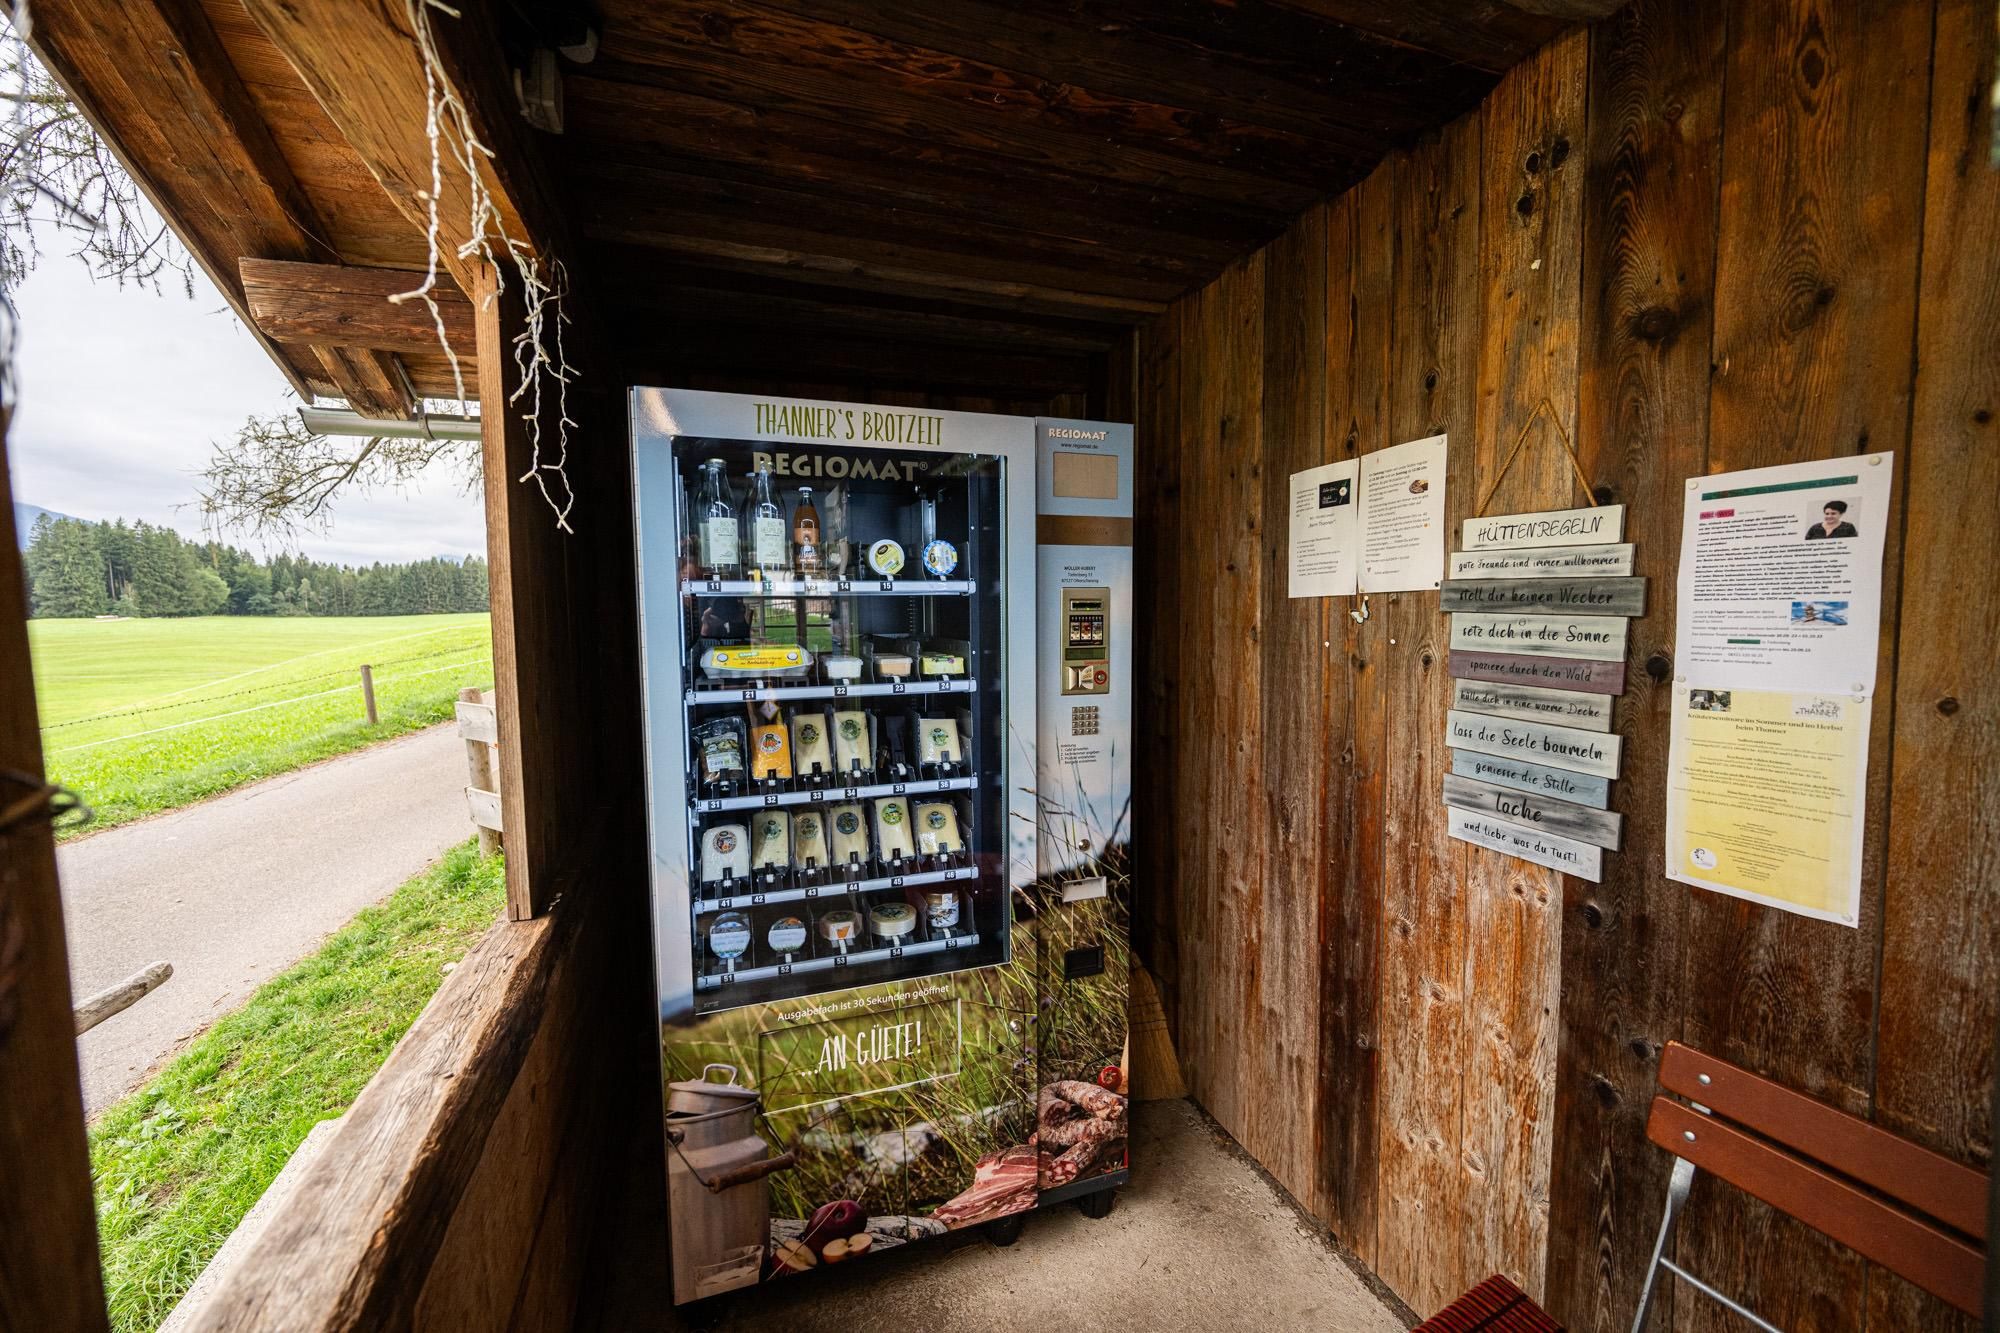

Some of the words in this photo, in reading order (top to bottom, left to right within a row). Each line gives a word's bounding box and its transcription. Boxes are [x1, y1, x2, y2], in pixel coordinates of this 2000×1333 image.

[862, 411, 945, 446] BROTZEIT
[1478, 516, 1604, 542] HÜTTENREGELN
[1458, 560, 1474, 572] gute
[1478, 558, 1510, 569] Freunde
[1513, 557, 1529, 568] sind
[1533, 558, 1560, 567] immer
[1564, 555, 1620, 567] willkommen
[711, 582, 720, 590] 11
[1459, 587, 1482, 601] stell
[1488, 587, 1505, 601] dir
[1512, 587, 1553, 602] keinen
[1559, 586, 1613, 604] Wecker
[1462, 625, 1483, 637] setz
[1488, 623, 1515, 639] dich
[1521, 629, 1532, 639] in
[1539, 625, 1558, 640] die
[1565, 625, 1610, 643] Sonne
[1470, 661, 1505, 673] spaziere
[1509, 662, 1538, 676] durch
[1543, 666, 1561, 678] den
[1565, 668, 1592, 682] Wald
[1460, 690, 1479, 702] hülle
[1482, 694, 1499, 704] dich
[1514, 700, 1531, 708] eine
[1535, 703, 1563, 713] warme
[1567, 703, 1600, 718] Decke
[1454, 722, 1472, 738] lass
[1478, 727, 1496, 743] die
[1501, 729, 1537, 749] Seele
[1543, 736, 1603, 761] baumeln
[895, 785, 904, 793] 35
[1475, 763, 1517, 780] geniesse
[1522, 770, 1538, 785] die
[1543, 774, 1576, 794] Stille
[767, 796, 776, 804] 32
[1496, 792, 1543, 823] lache
[1464, 821, 1480, 834] und
[1513, 837, 1529, 848] was
[1534, 841, 1547, 855] du
[849, 883, 858, 891] 44
[777, 1003, 839, 1022] Ausgabefach
[840, 1002, 851, 1011] ist
[853, 999, 865, 1008] 30
[866, 991, 911, 1006] Sekunden
[912, 984, 950, 1000] geöffnet
[857, 1021, 921, 1066] GÜETE!
